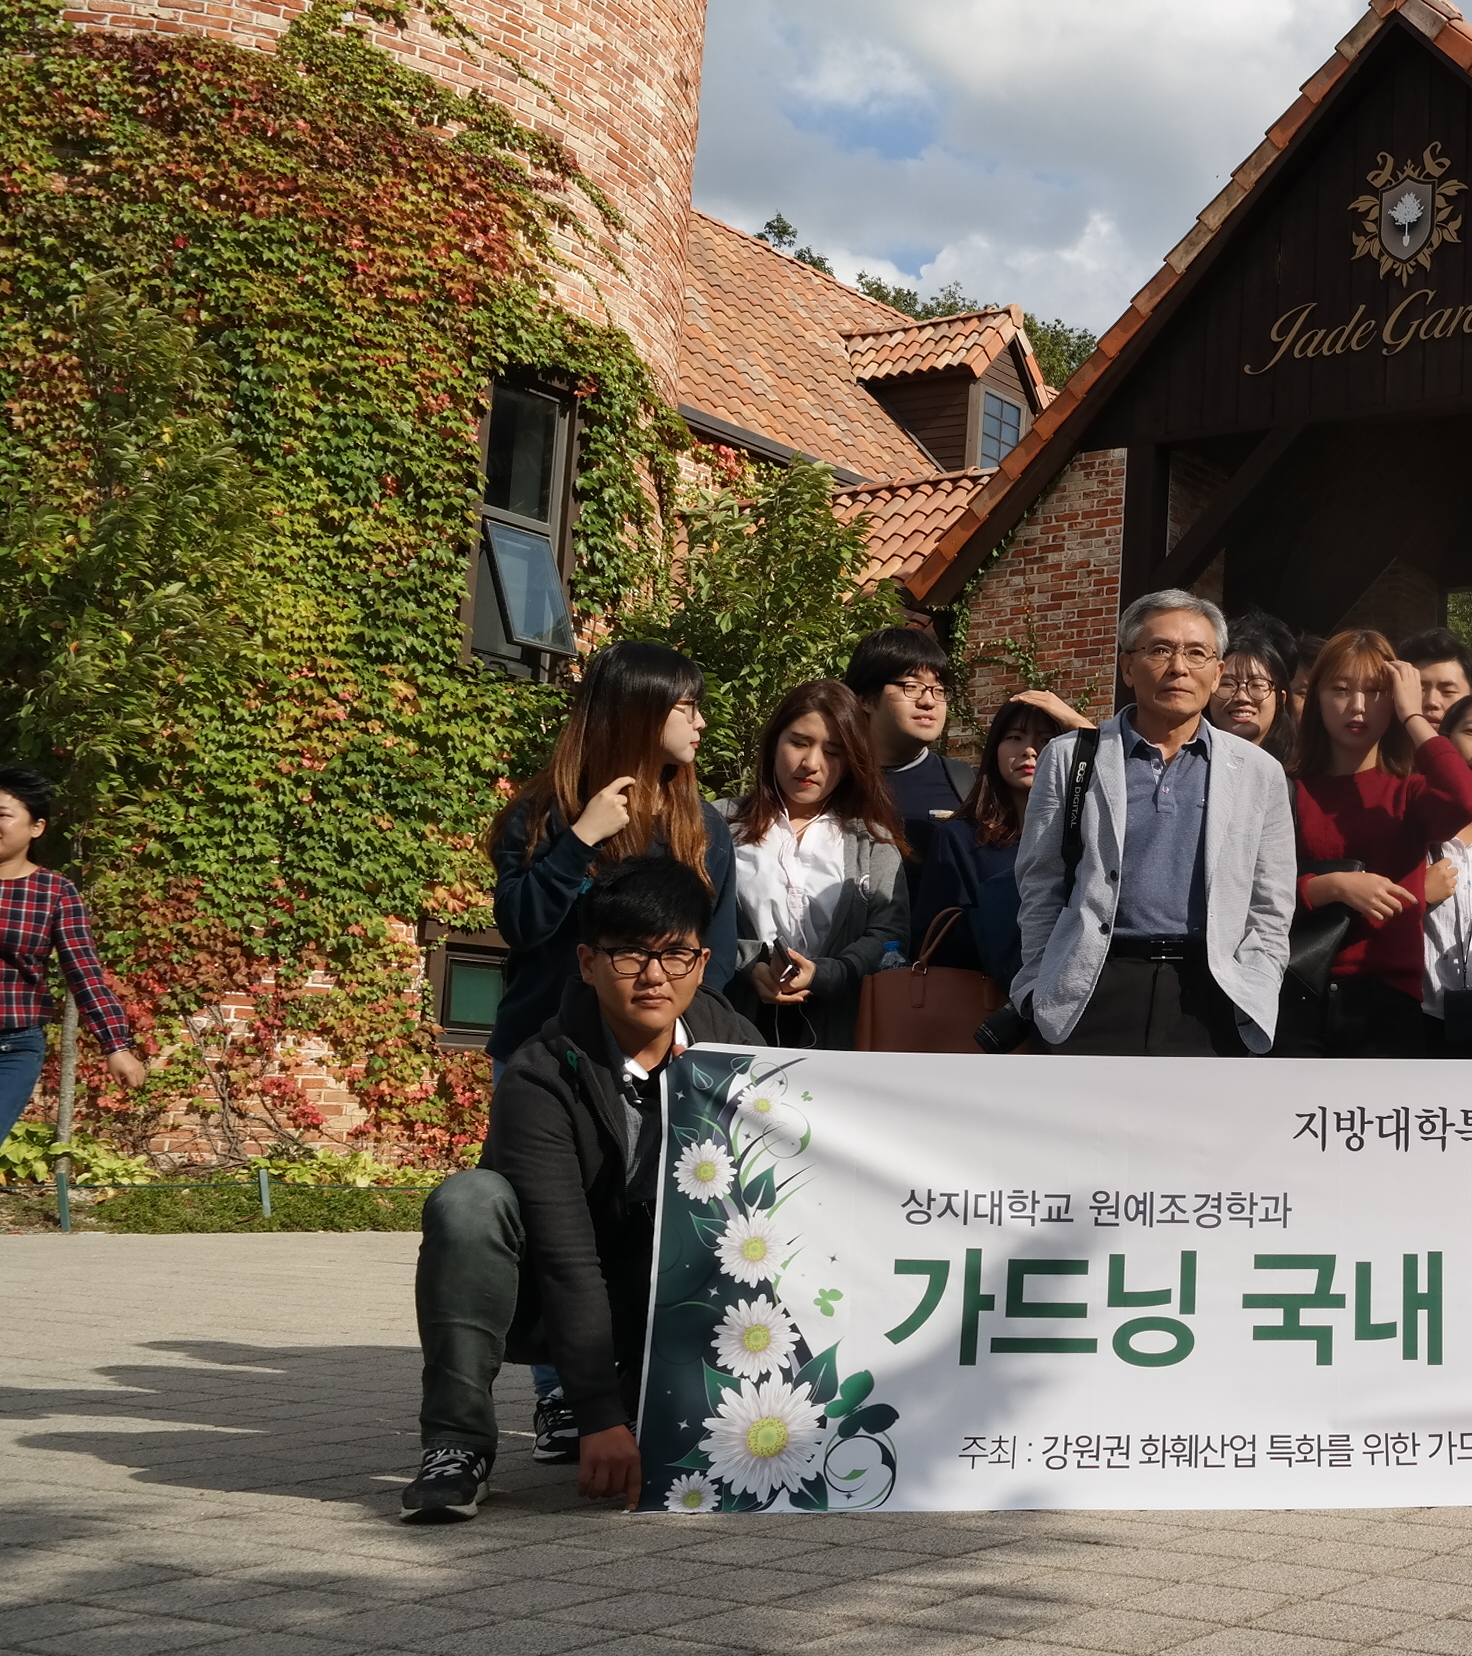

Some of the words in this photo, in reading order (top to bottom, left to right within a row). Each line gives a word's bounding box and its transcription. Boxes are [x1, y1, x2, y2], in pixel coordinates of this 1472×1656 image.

[1243, 302, 1378, 376] Jade
[1075, 761, 1087, 783] EOS
[1070, 786, 1082, 829] DIGITAL
[900, 1188, 1075, 1227] 상지대학교
[1088, 1190, 1293, 1229] 원예조경학과
[885, 1248, 1198, 1368] 가드닝
[1241, 1250, 1443, 1366] 국내
[958, 1434, 1017, 1470] 주최
[1041, 1434, 1131, 1471] 강원권
[1138, 1433, 1256, 1469] 화훼산업
[1265, 1433, 1355, 1468] 특화를
[1362, 1431, 1421, 1467] 위한
